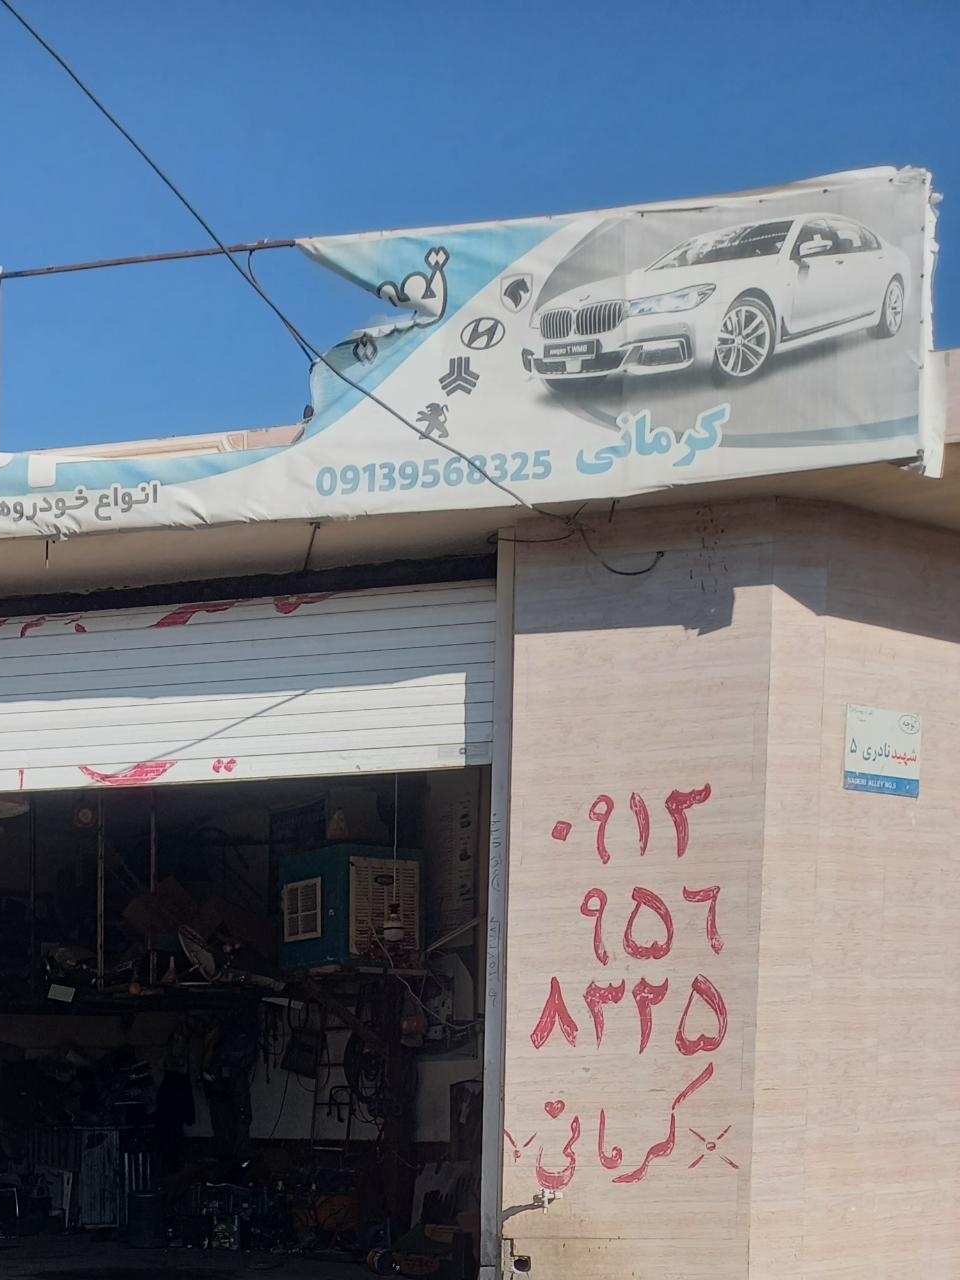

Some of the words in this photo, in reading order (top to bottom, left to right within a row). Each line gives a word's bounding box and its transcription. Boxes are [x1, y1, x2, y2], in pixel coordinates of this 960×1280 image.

[575, 405, 729, 475] کرمانی
[94, 483, 159, 522] انواع
[315, 449, 553, 497] 09139568325
[849, 737, 858, 753] ۵
[862, 742, 890, 762] نادری
[891, 748, 918, 766] شهید
[551, 782, 712, 865] ۰۹۱۳
[579, 885, 725, 966] ۹۵۶
[529, 973, 728, 1056] ۸۳۲۵
[536, 1061, 714, 1191] کرمانی
